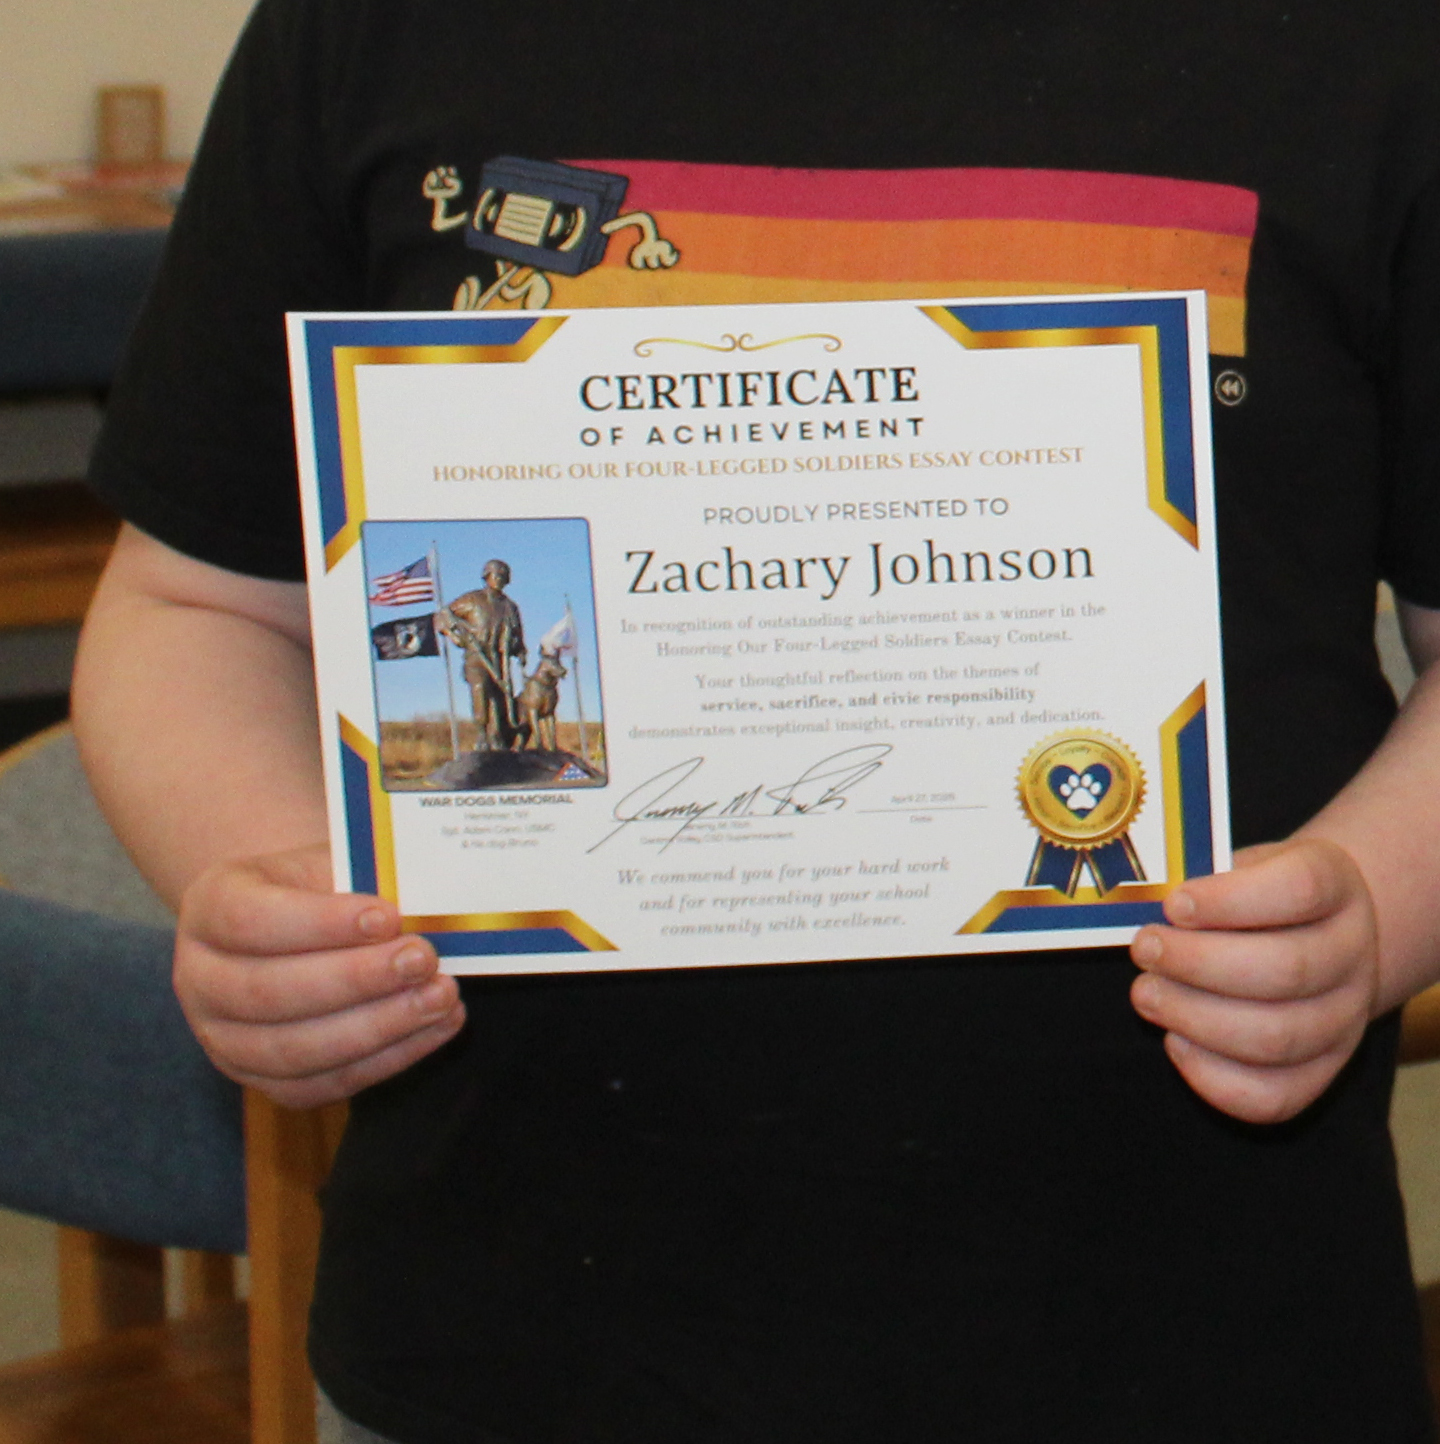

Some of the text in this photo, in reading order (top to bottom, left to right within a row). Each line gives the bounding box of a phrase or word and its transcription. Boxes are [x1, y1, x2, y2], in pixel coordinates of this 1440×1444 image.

[578, 366, 919, 411] CERTIFICATE
[579, 416, 924, 446] OF ACHIEVEMENT
[433, 446, 1083, 481] HONORING OUR FOUR-LEGGED SOLDIERS ESSAY CONTEST
[703, 496, 1009, 524] PROUDLY PRESENTED TO
[624, 538, 1094, 600] Zachary Johnson
[620, 601, 1107, 635] In recognition of outstanding achievement as a winner in the
[656, 628, 1073, 657] Honoring Our Four-Legged Soldiers Essay Contest.
[694, 661, 1040, 689] Your thoughtful reflection on the themes of
[700, 686, 1036, 712] service, sacrifice, and civic responsibility
[628, 708, 1105, 739] demonstrates exceptional insight, creativity, and dedication.
[419, 794, 574, 807] WAR DOGS MEMORIAL
[617, 855, 950, 884] We commend you for your hard work
[638, 882, 931, 913] and for representing your school
[660, 917, 763, 937] community
[767, 914, 808, 932] with
